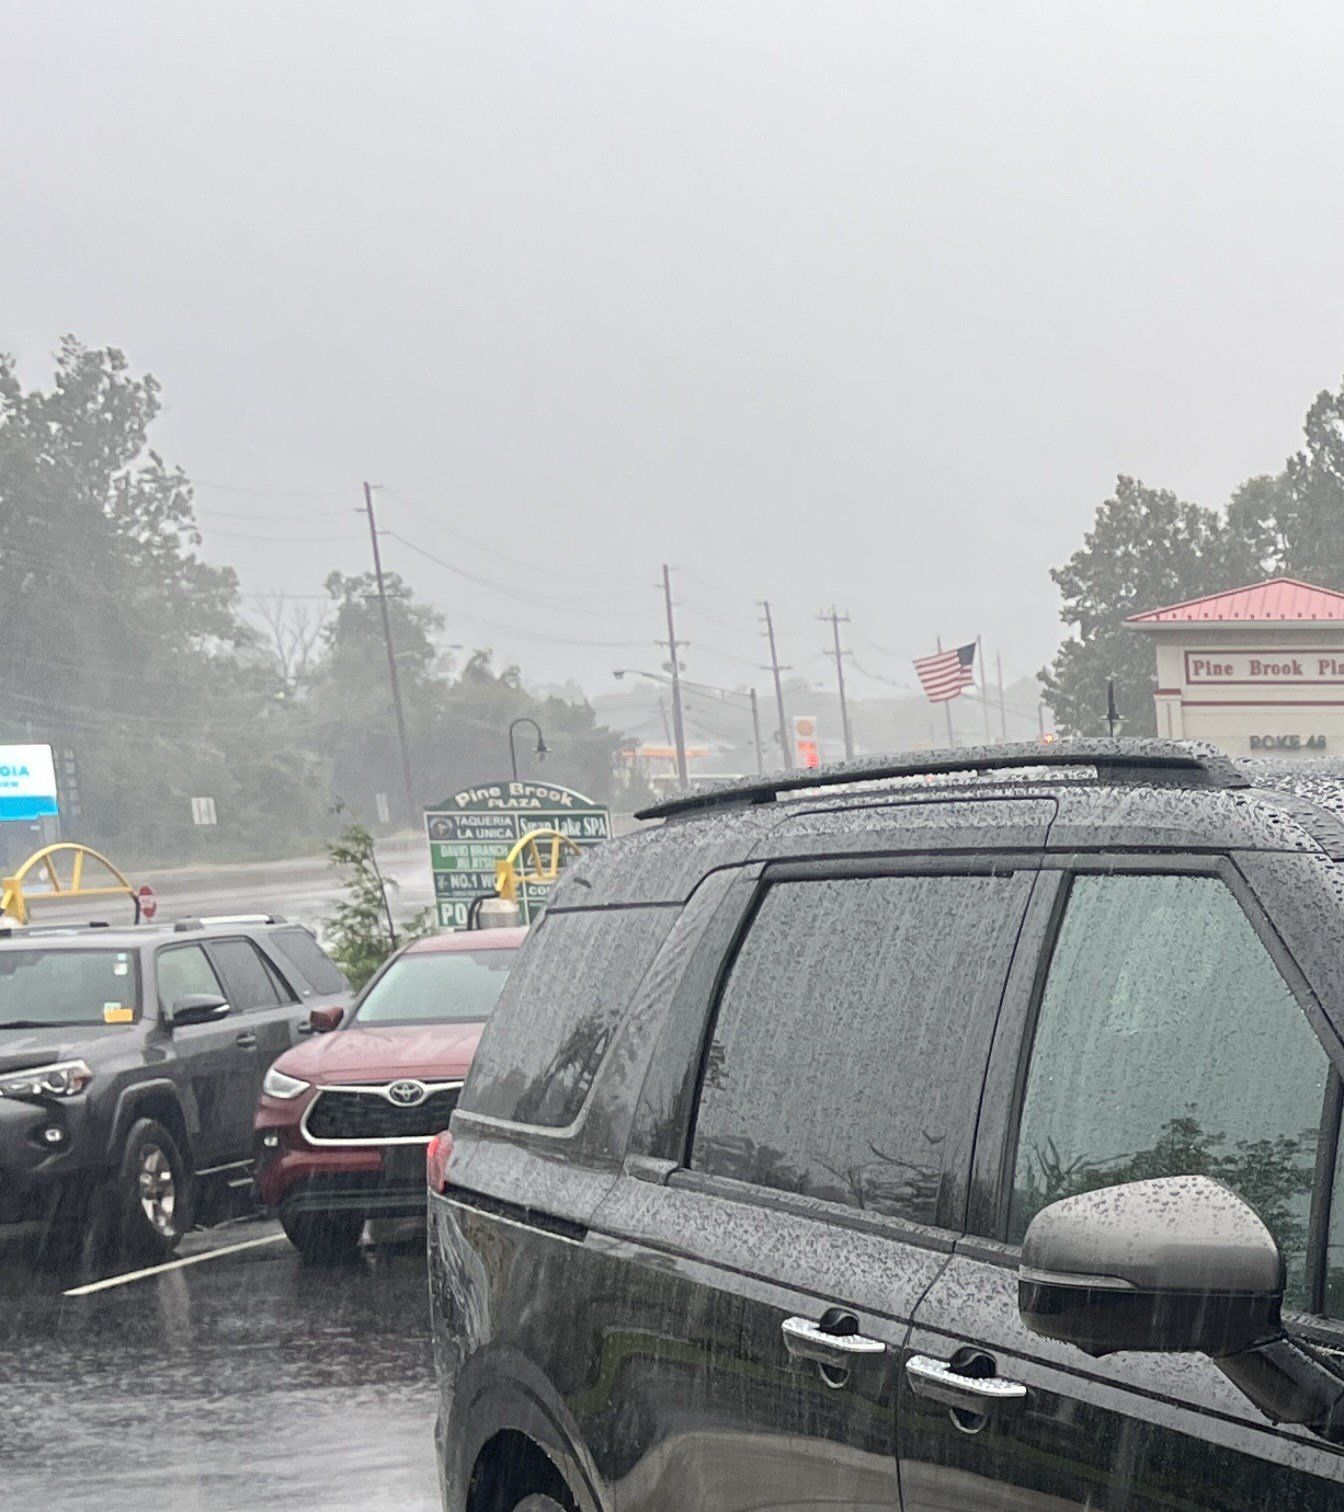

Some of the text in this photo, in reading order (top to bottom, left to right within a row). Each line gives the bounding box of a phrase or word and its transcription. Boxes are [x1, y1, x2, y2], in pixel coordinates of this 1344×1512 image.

[1192, 659, 1234, 676] Pine
[1249, 659, 1304, 676] Brook
[455, 782, 573, 808] Pine Brook
[487, 798, 541, 808] PLAZA
[454, 815, 513, 827] TAQUERIA
[583, 816, 607, 837] SPA
[456, 828, 514, 839] LA UNICA
